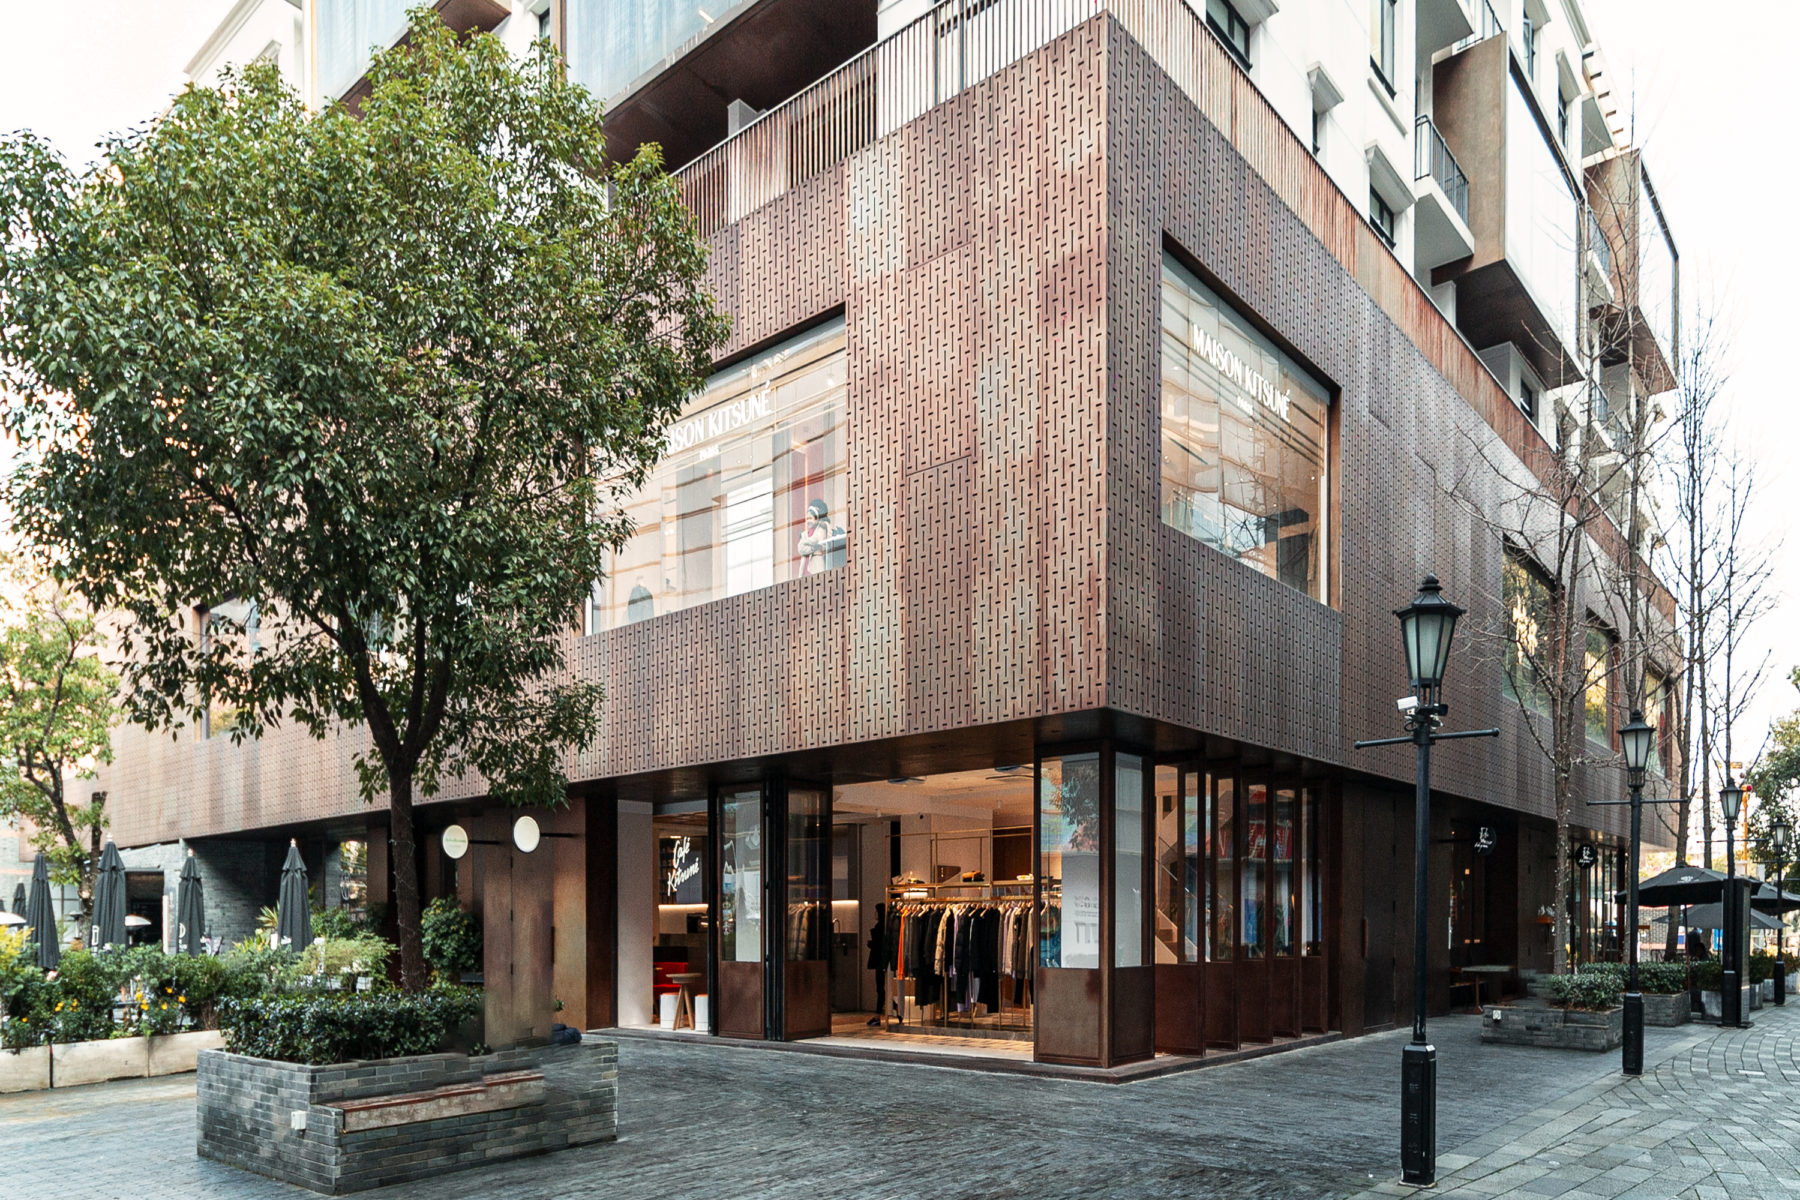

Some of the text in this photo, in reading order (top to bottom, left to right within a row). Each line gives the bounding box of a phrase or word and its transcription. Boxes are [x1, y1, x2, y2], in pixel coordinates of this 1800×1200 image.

[1192, 324, 1291, 423] MAISON KITSUNÉ
[708, 379, 772, 436] KITSUNÉ
[673, 835, 691, 869] Café
[667, 857, 700, 897] Kitsuné
